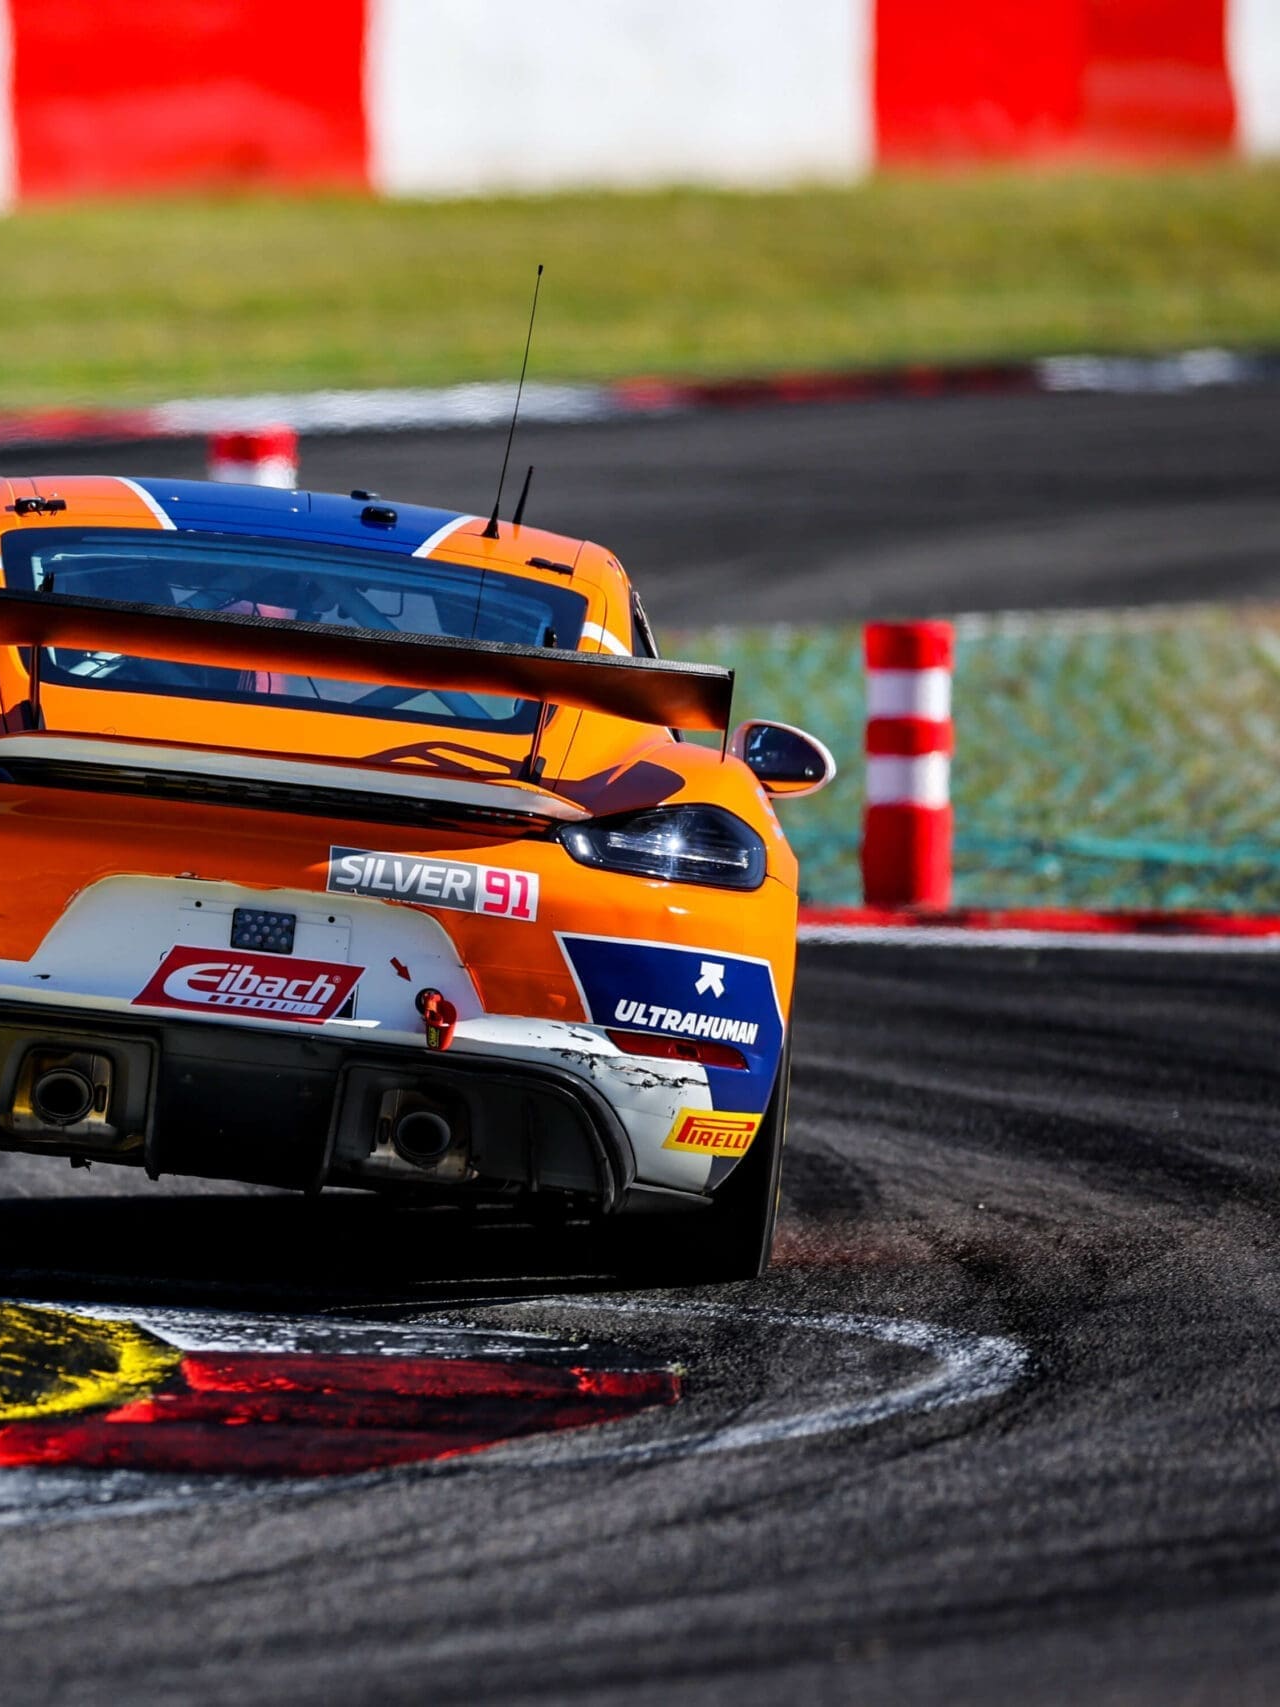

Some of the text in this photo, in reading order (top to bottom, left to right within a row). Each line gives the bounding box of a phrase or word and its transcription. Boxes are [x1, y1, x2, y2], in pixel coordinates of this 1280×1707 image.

[335, 855, 531, 919] SILVER 91
[163, 962, 336, 1004] Eibach
[614, 999, 759, 1045] ULTRAHUMAN
[675, 1116, 756, 1149] PIRELLI
